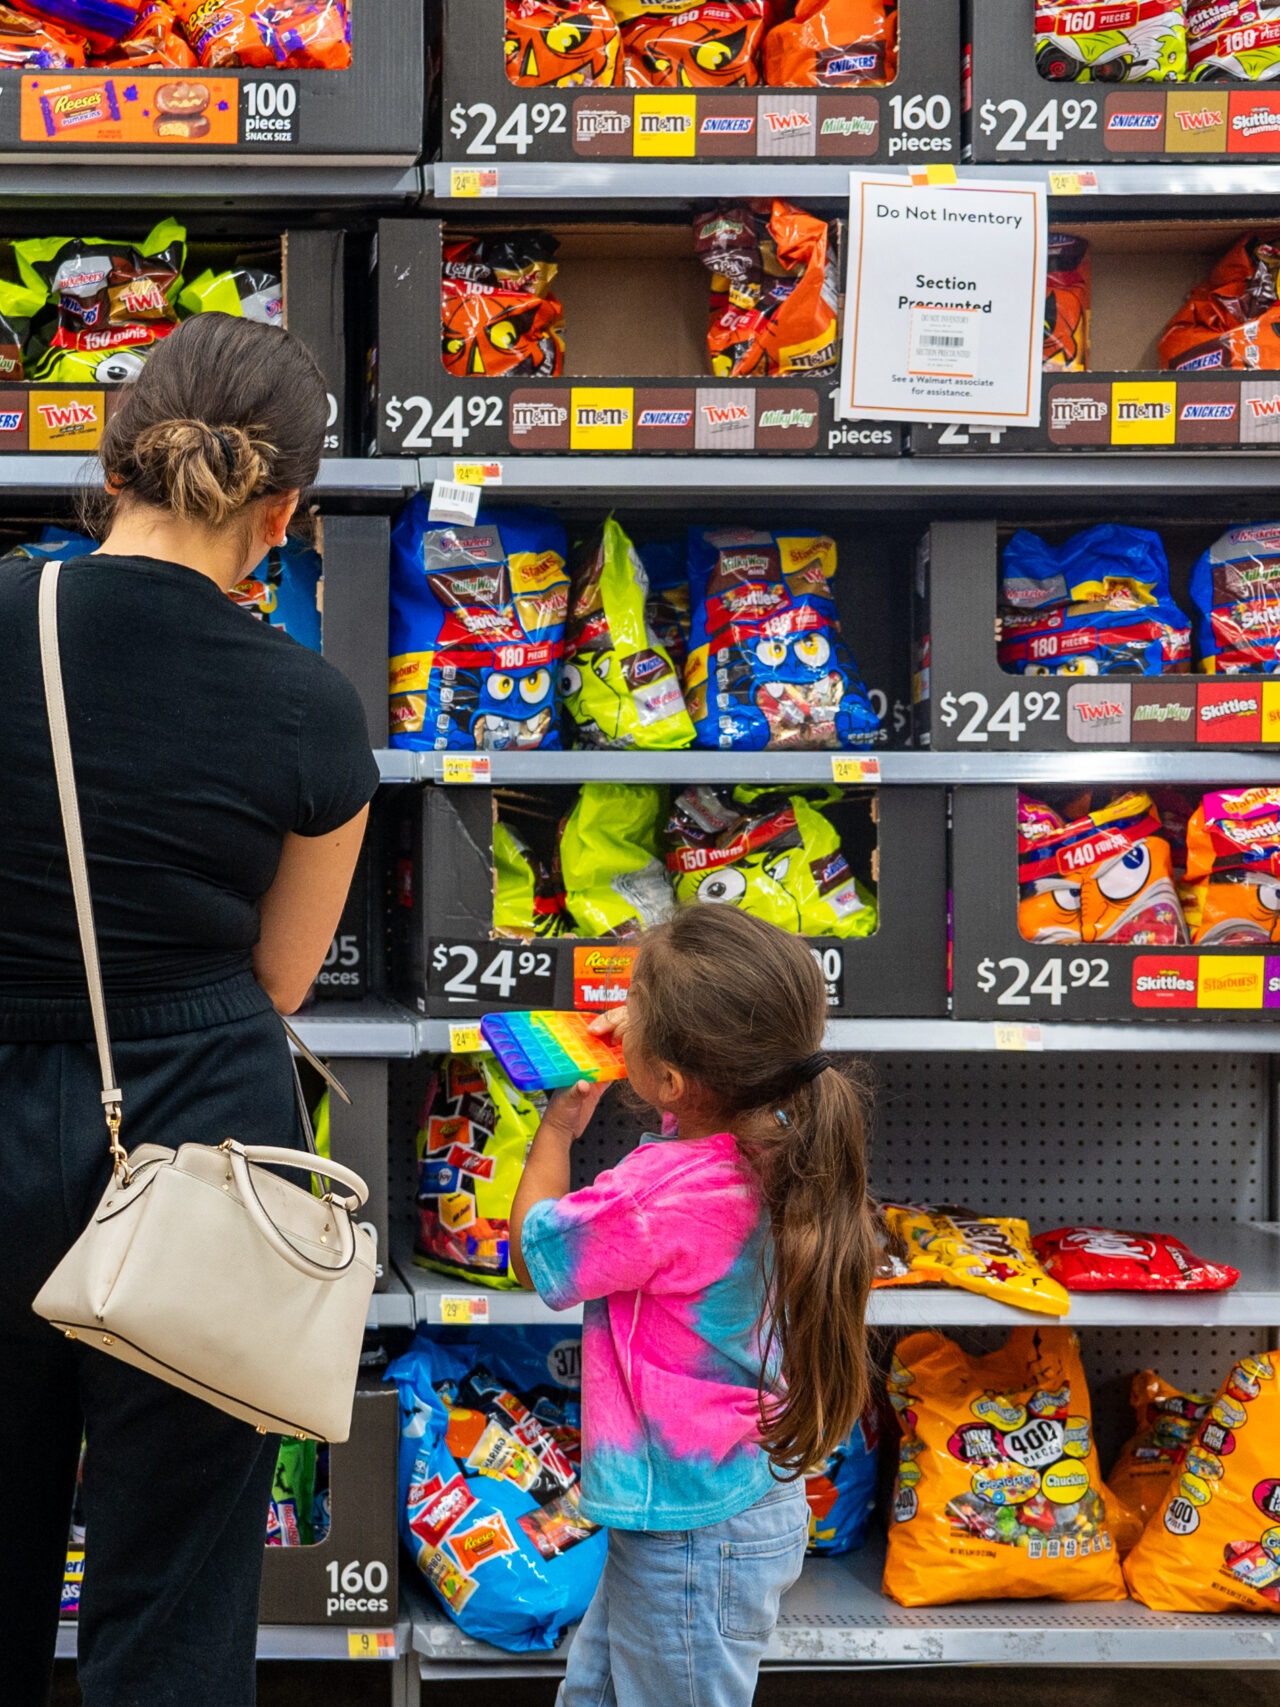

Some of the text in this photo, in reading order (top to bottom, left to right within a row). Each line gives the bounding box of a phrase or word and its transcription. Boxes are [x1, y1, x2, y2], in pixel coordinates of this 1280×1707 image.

[670, 10, 699, 27] 160
[1064, 11, 1131, 33] 160 PIECES
[1224, 29, 1256, 54] 160
[243, 83, 296, 116] 100
[889, 95, 950, 129] 160
[1110, 115, 1160, 127] SNICKERS
[246, 116, 291, 132] pieces
[703, 119, 751, 131] SNICKERS
[246, 132, 292, 141] SNACK SIZE
[888, 134, 952, 152] pieces
[877, 205, 1022, 229] Do Not Inventory
[916, 275, 976, 290] Section
[85, 332, 110, 348] 150
[916, 376, 952, 384] Walmart
[955, 378, 994, 387] associate
[912, 387, 973, 397] for assistance.
[641, 411, 689, 424] SNICKERS
[1183, 405, 1233, 418] SNICKERS
[828, 426, 892, 448] pieces
[1032, 637, 1057, 657] 180
[499, 648, 547, 667] 180 PIECES
[1201, 699, 1257, 720] Skittles
[681, 849, 706, 868] 150
[1063, 844, 1095, 868] 140
[1136, 976, 1194, 991] Skittles
[1203, 973, 1258, 992] Starburst
[1011, 1421, 1057, 1454] 400
[483, 1438, 507, 1468] HARIBO
[1023, 1443, 1061, 1464] PIECES
[1047, 1476, 1086, 1486] Chuckles
[326, 1561, 388, 1593] 160
[327, 1595, 388, 1616] pieces
